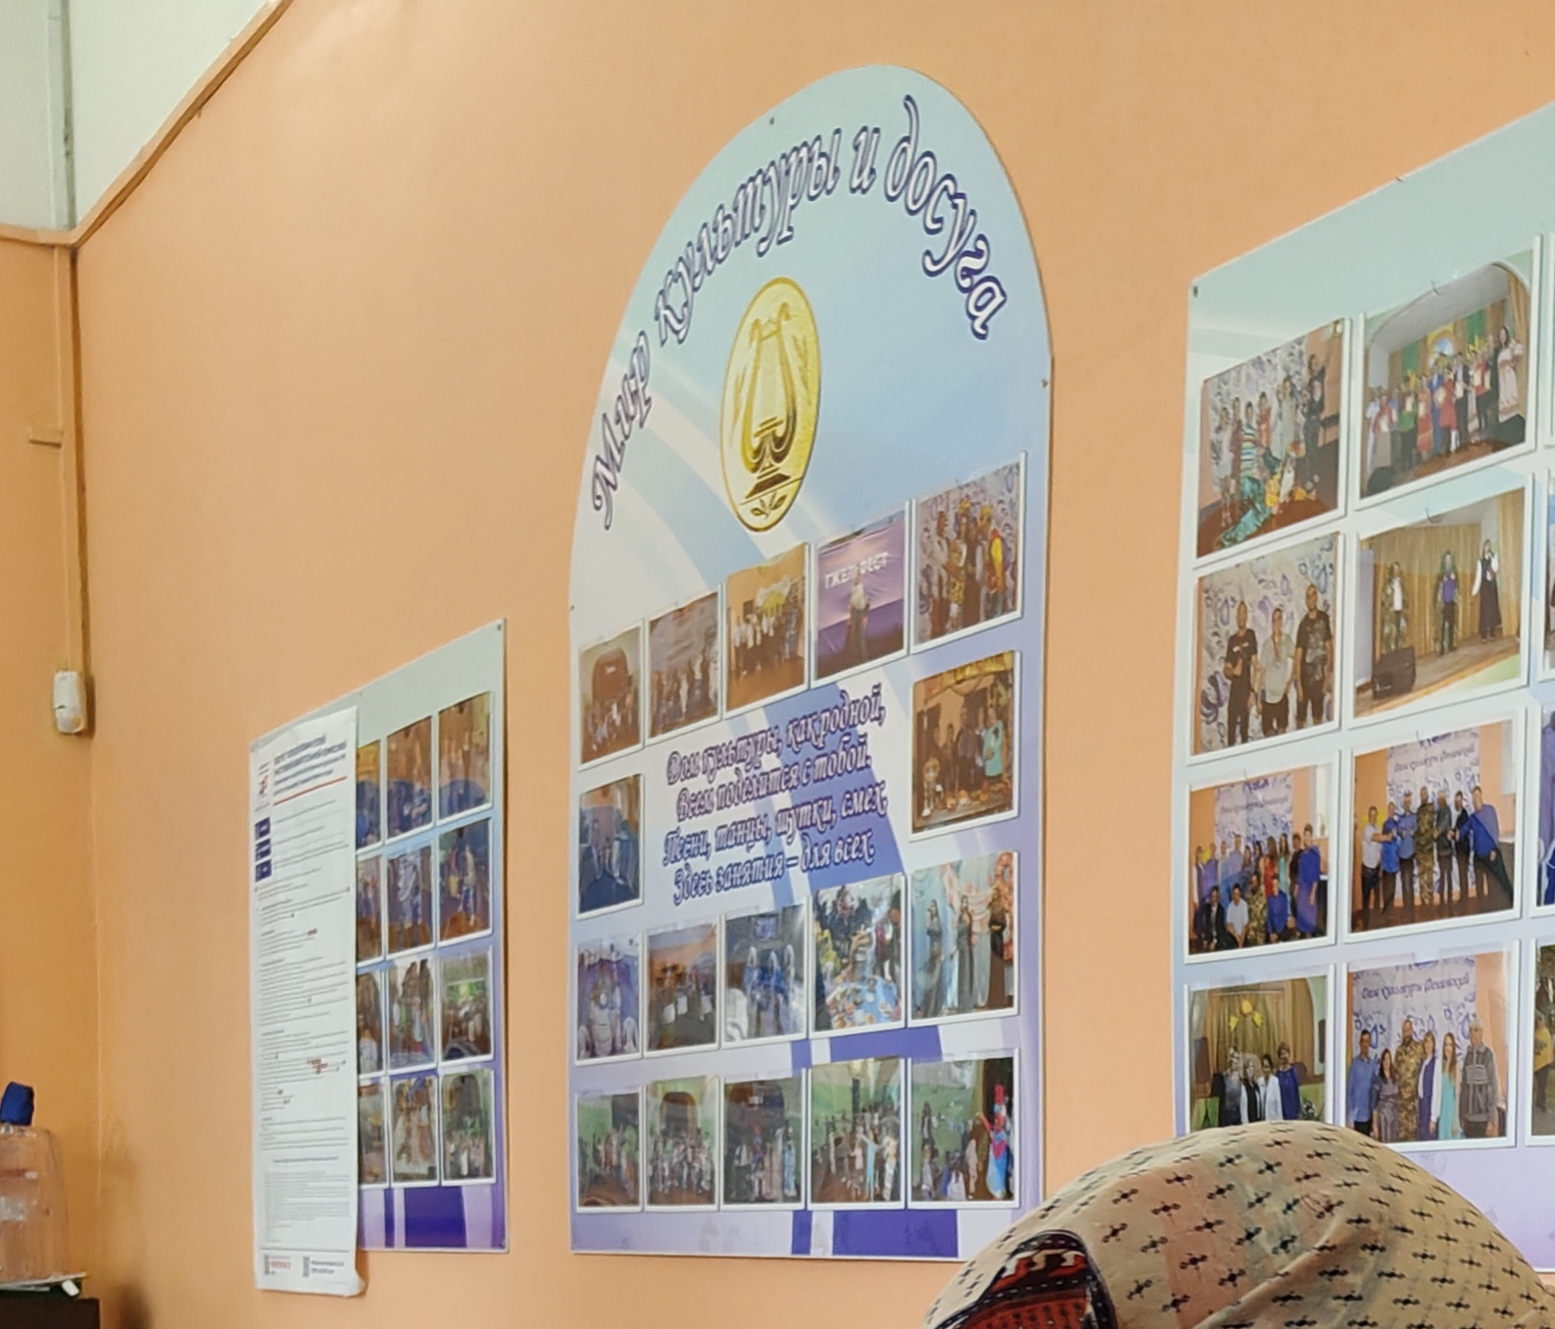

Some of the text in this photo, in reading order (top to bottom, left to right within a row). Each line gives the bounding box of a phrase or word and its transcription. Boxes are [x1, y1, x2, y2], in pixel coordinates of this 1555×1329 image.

[592, 95, 1007, 531] Мир культуры и досуга
[667, 751, 699, 786] Дом
[785, 716, 819, 754] как
[818, 683, 886, 750] родной,
[676, 732, 872, 822] Всем поделится с тобой.
[775, 795, 837, 846] шутки,
[674, 863, 713, 906] Здесь
[715, 852, 785, 893] занятия
[801, 832, 830, 873] для
